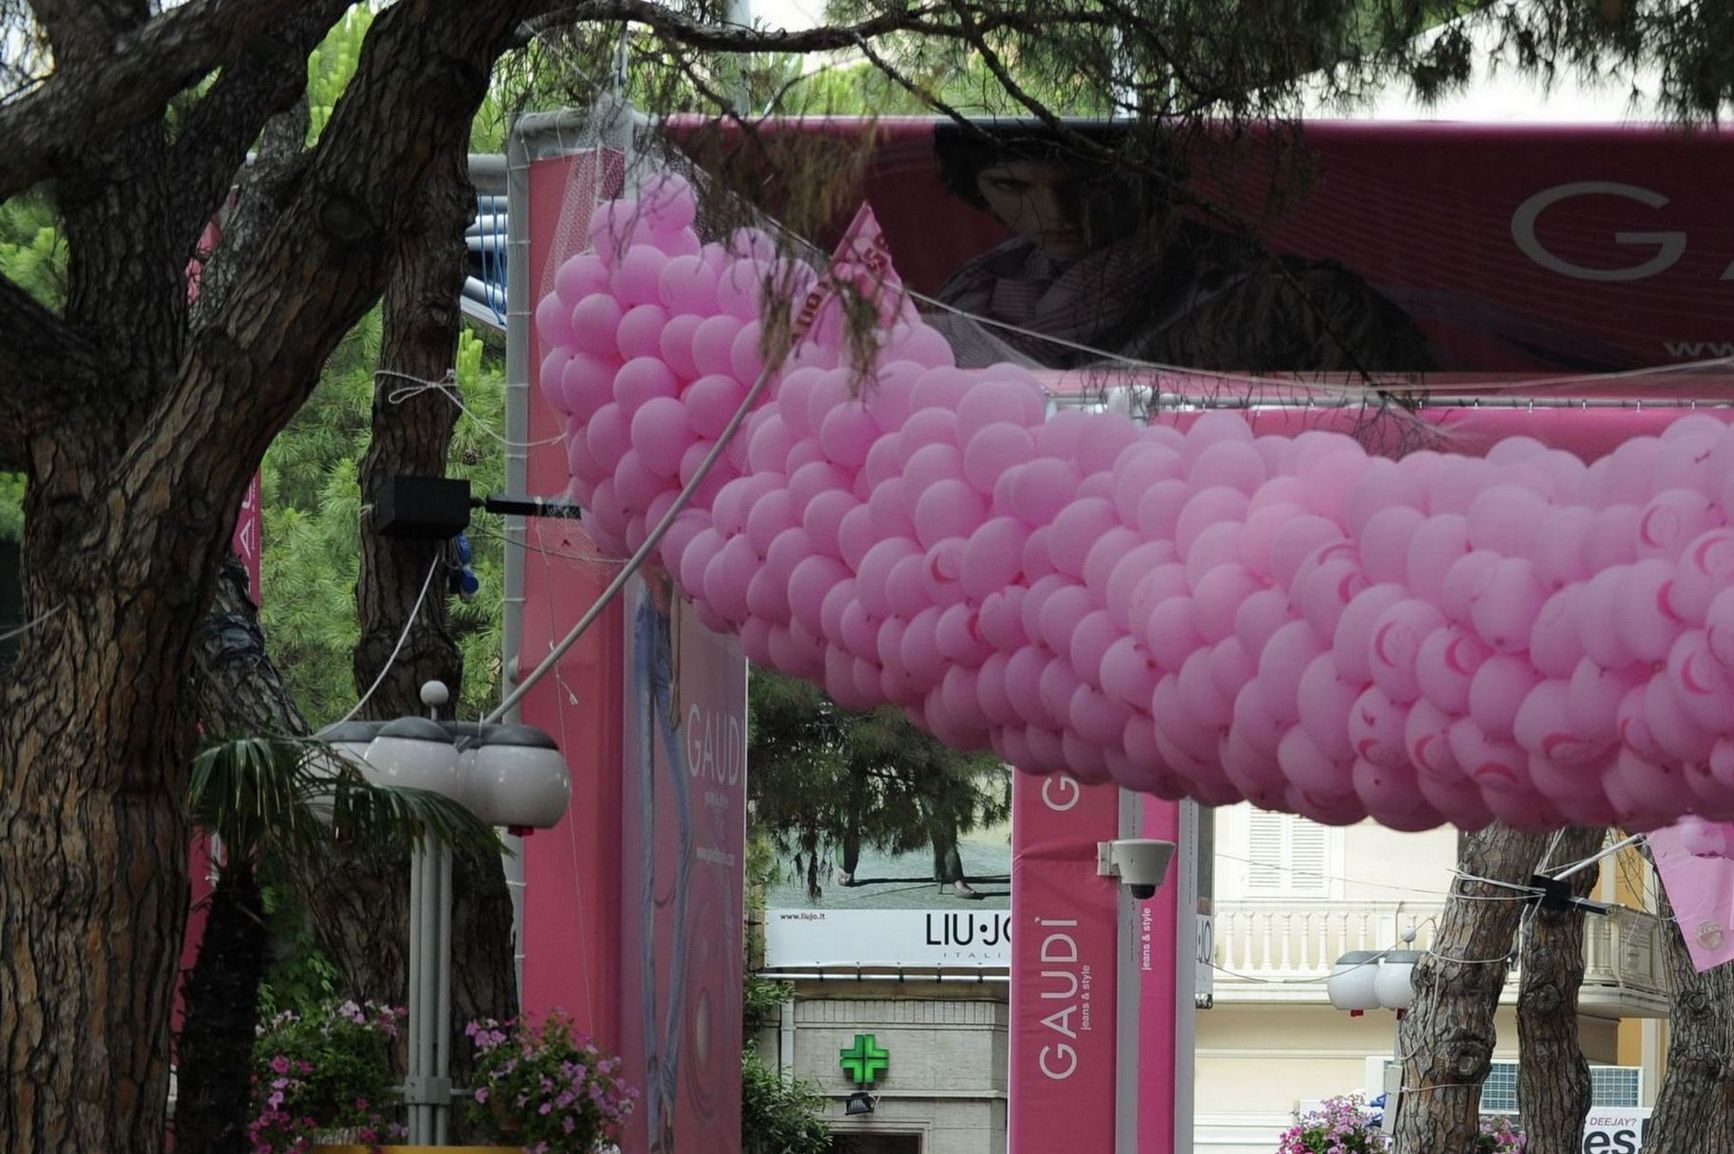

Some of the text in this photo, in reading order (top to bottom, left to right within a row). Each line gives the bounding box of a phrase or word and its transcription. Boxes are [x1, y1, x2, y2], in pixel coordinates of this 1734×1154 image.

[780, 912, 825, 921] www.liujo.it
[1141, 907, 1152, 971] jeans & style
[1080, 964, 1092, 1031] jeans & style
[1590, 1117, 1637, 1127] DEEJAY?
